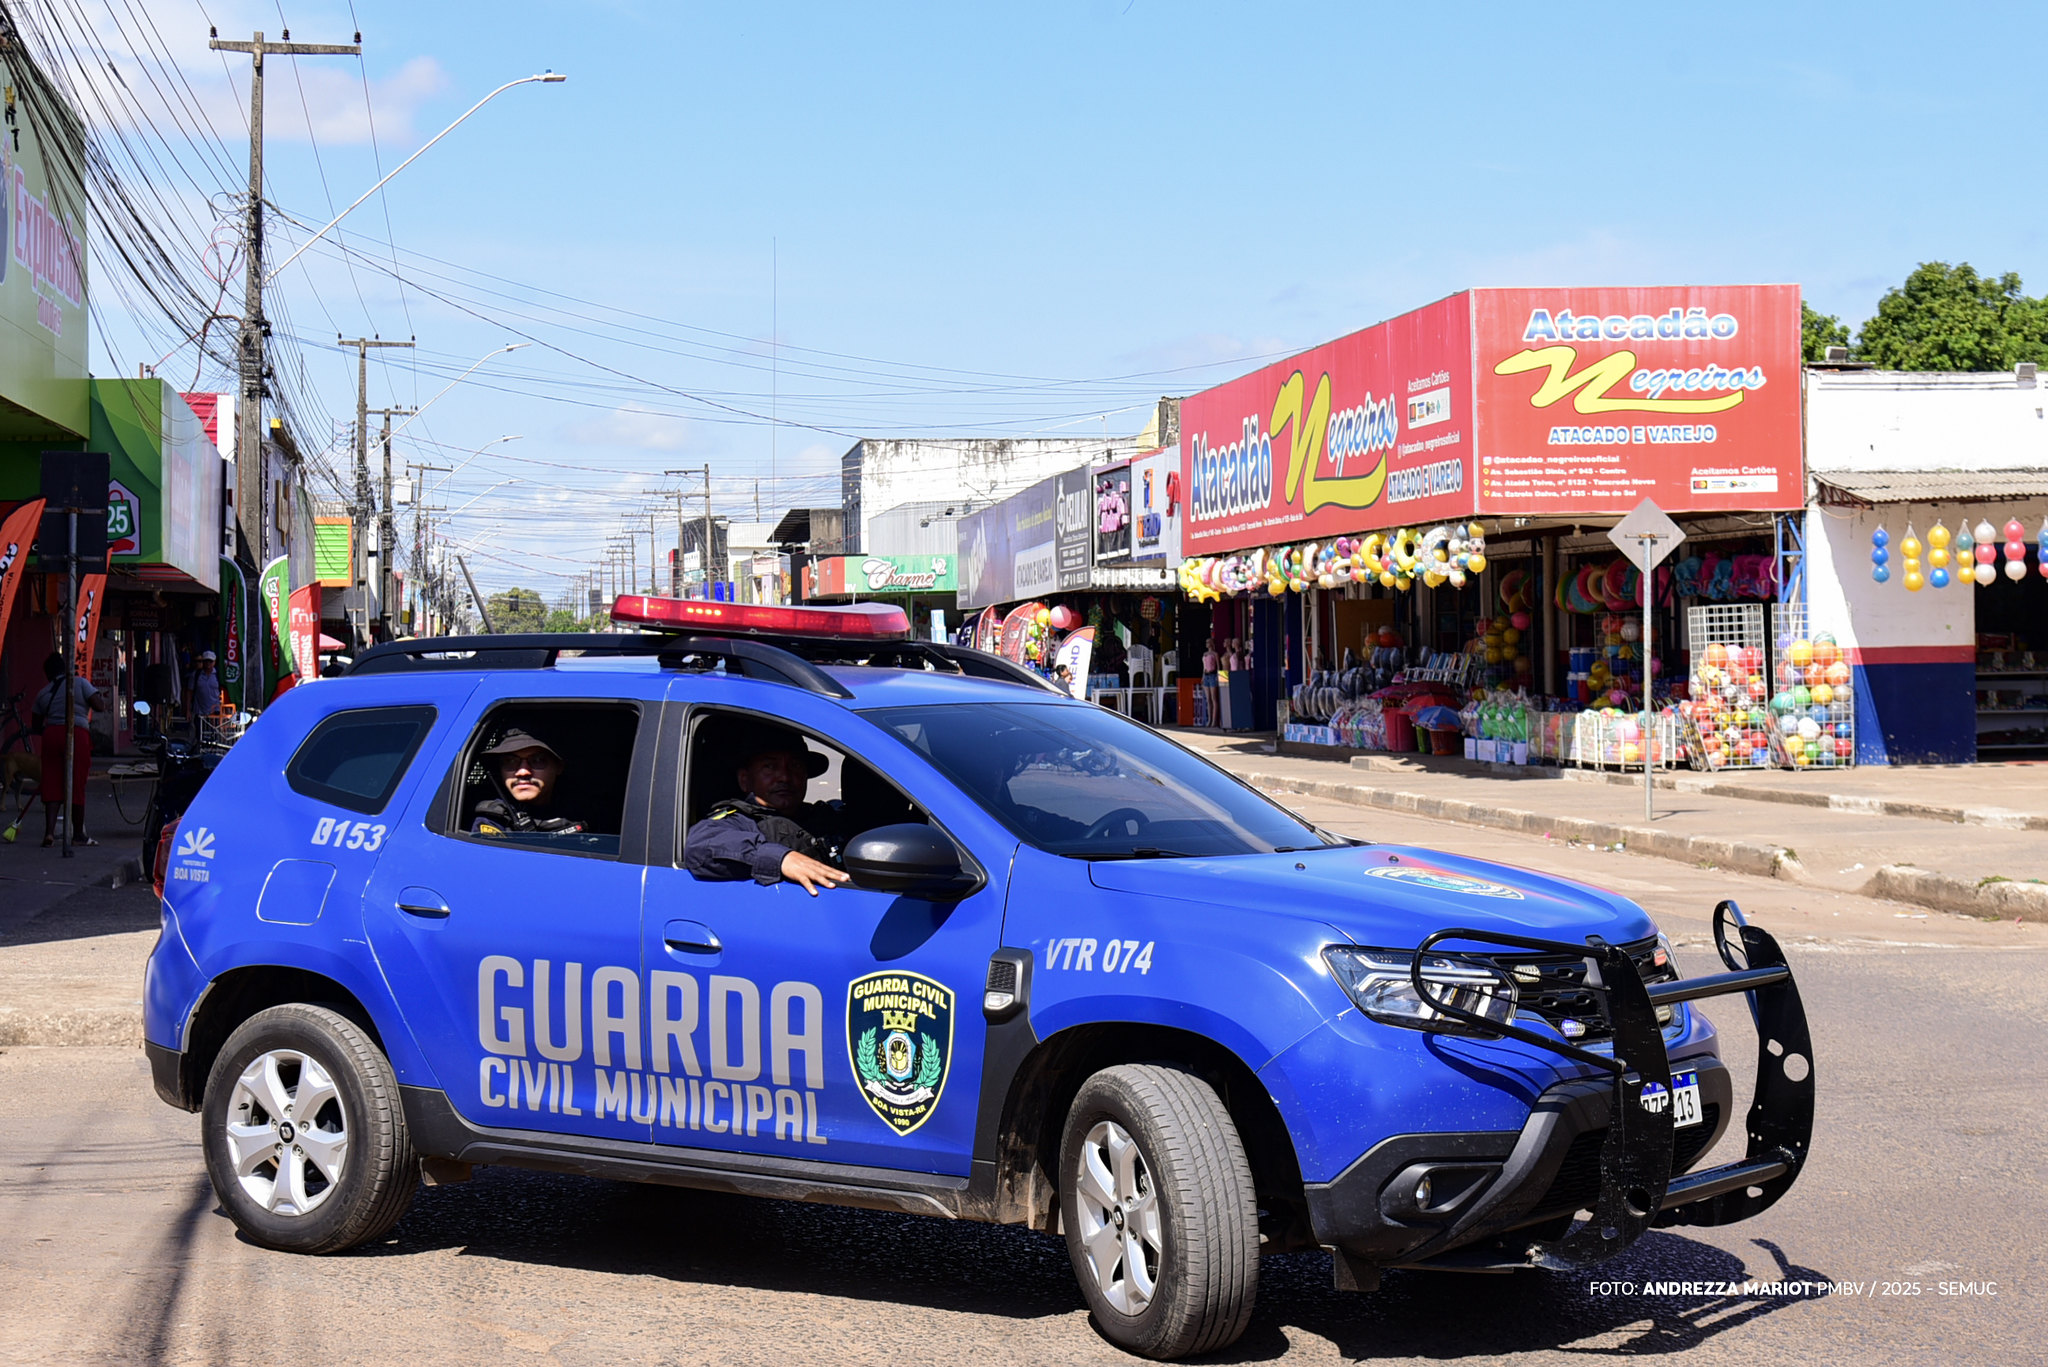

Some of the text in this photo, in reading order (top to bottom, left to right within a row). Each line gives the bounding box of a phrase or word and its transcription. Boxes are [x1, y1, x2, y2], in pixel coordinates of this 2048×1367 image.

[1523, 307, 1738, 341] Atacadão
[1407, 377, 1431, 393] Aceitamos
[1494, 345, 1767, 414] Negreiros
[1270, 369, 1398, 516] Negreiros
[1548, 424, 1717, 445] ATACADO E VAREJO
[1190, 414, 1272, 522] Atacadão
[1387, 458, 1463, 504] ATACADO E VAREJO
[1691, 465, 1777, 475] Aceitamos Cartões
[106, 505, 128, 533] 25
[333, 820, 387, 852] 153
[173, 866, 210, 882] BOA VISTA
[1045, 938, 1155, 975] VTR 074
[853, 978, 948, 1010] GUARDA CIVIL
[863, 994, 937, 1020] MUNICIPAL
[478, 955, 824, 1089] GUARDA
[479, 1056, 828, 1144] CIVIL MUNICIPAL
[872, 1096, 888, 1112] BOA
